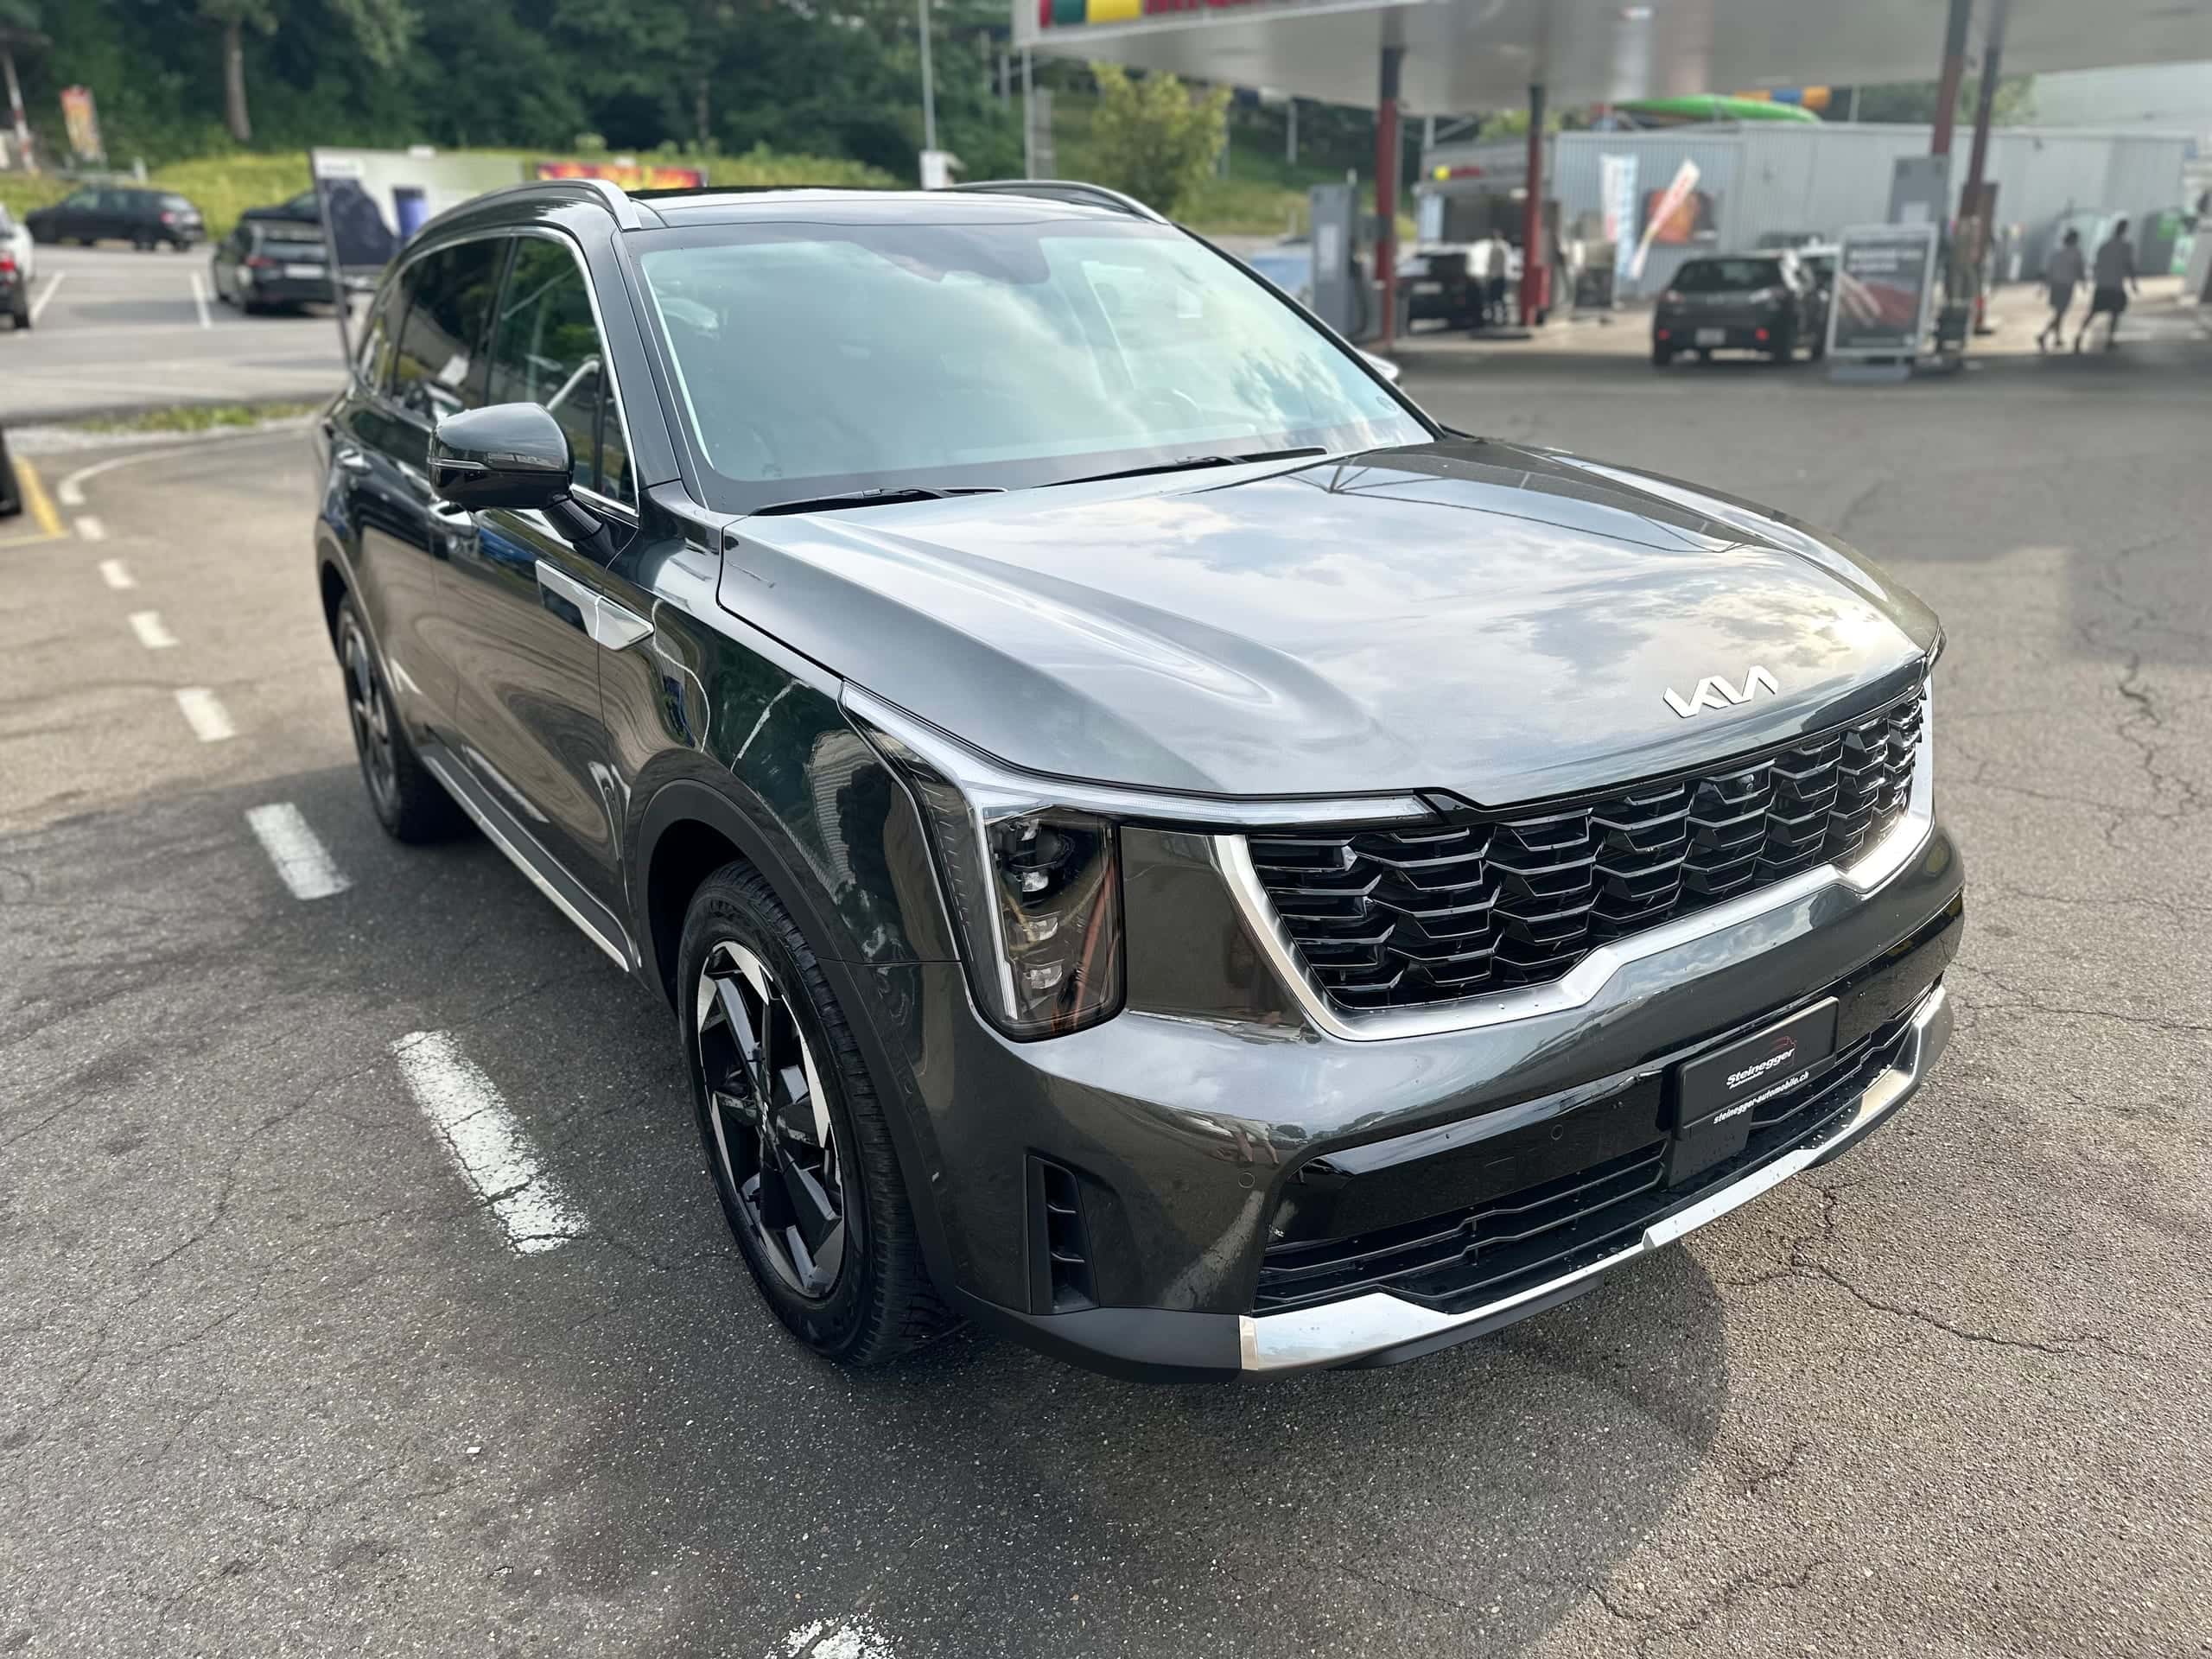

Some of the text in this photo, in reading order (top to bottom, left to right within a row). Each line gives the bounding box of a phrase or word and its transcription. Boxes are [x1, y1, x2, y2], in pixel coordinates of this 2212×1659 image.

[1663, 665, 1778, 718] KIA
[1726, 1048, 1796, 1085] Steinegger
[1713, 1071, 1809, 1124] steinegger-automobile.ch
